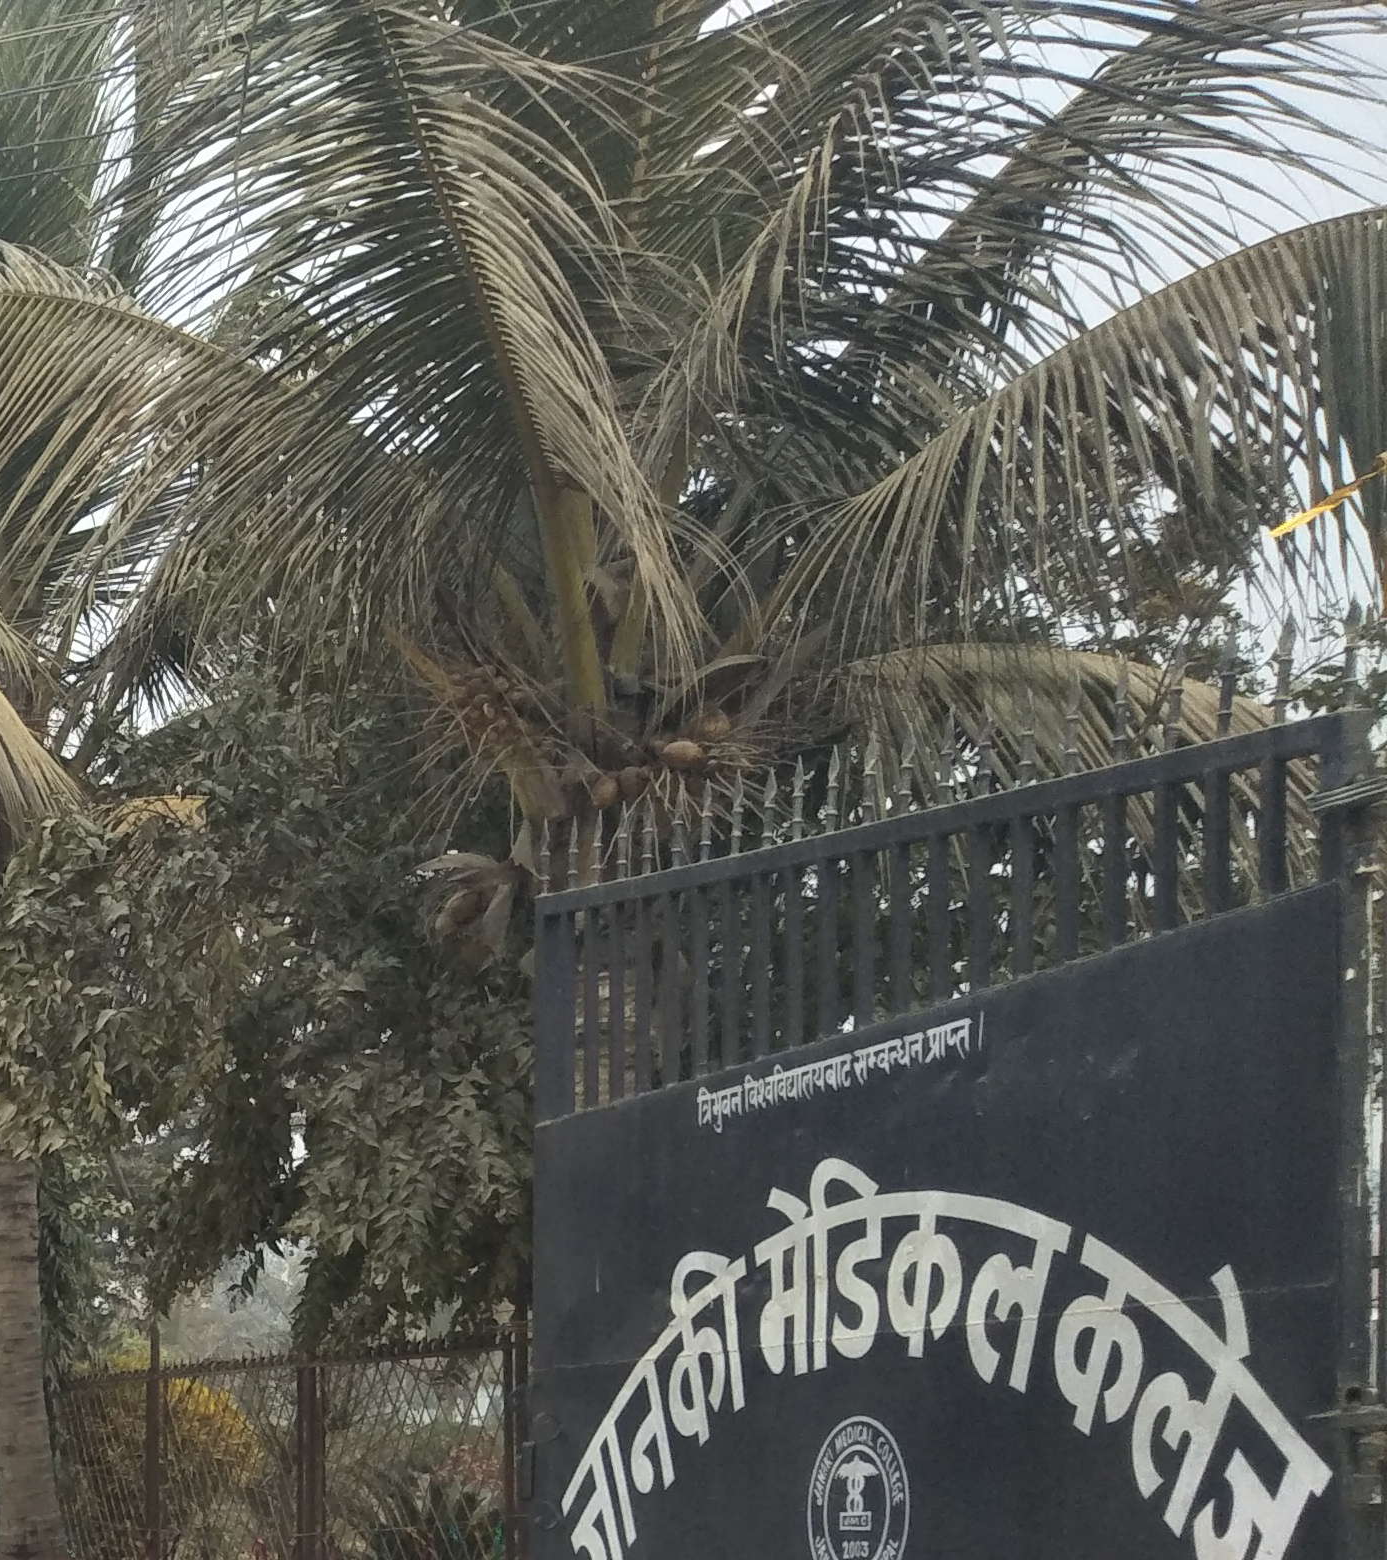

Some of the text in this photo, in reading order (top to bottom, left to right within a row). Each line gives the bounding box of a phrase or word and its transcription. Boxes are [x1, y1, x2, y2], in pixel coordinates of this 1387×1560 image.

[697, 1086, 743, 1134] त्रिभुवन
[753, 1157, 1071, 1396] मेडिकल
[810, 1424, 905, 1507] JANAKI MEDICAL COLLEGE
[841, 1540, 870, 1560] 2003
